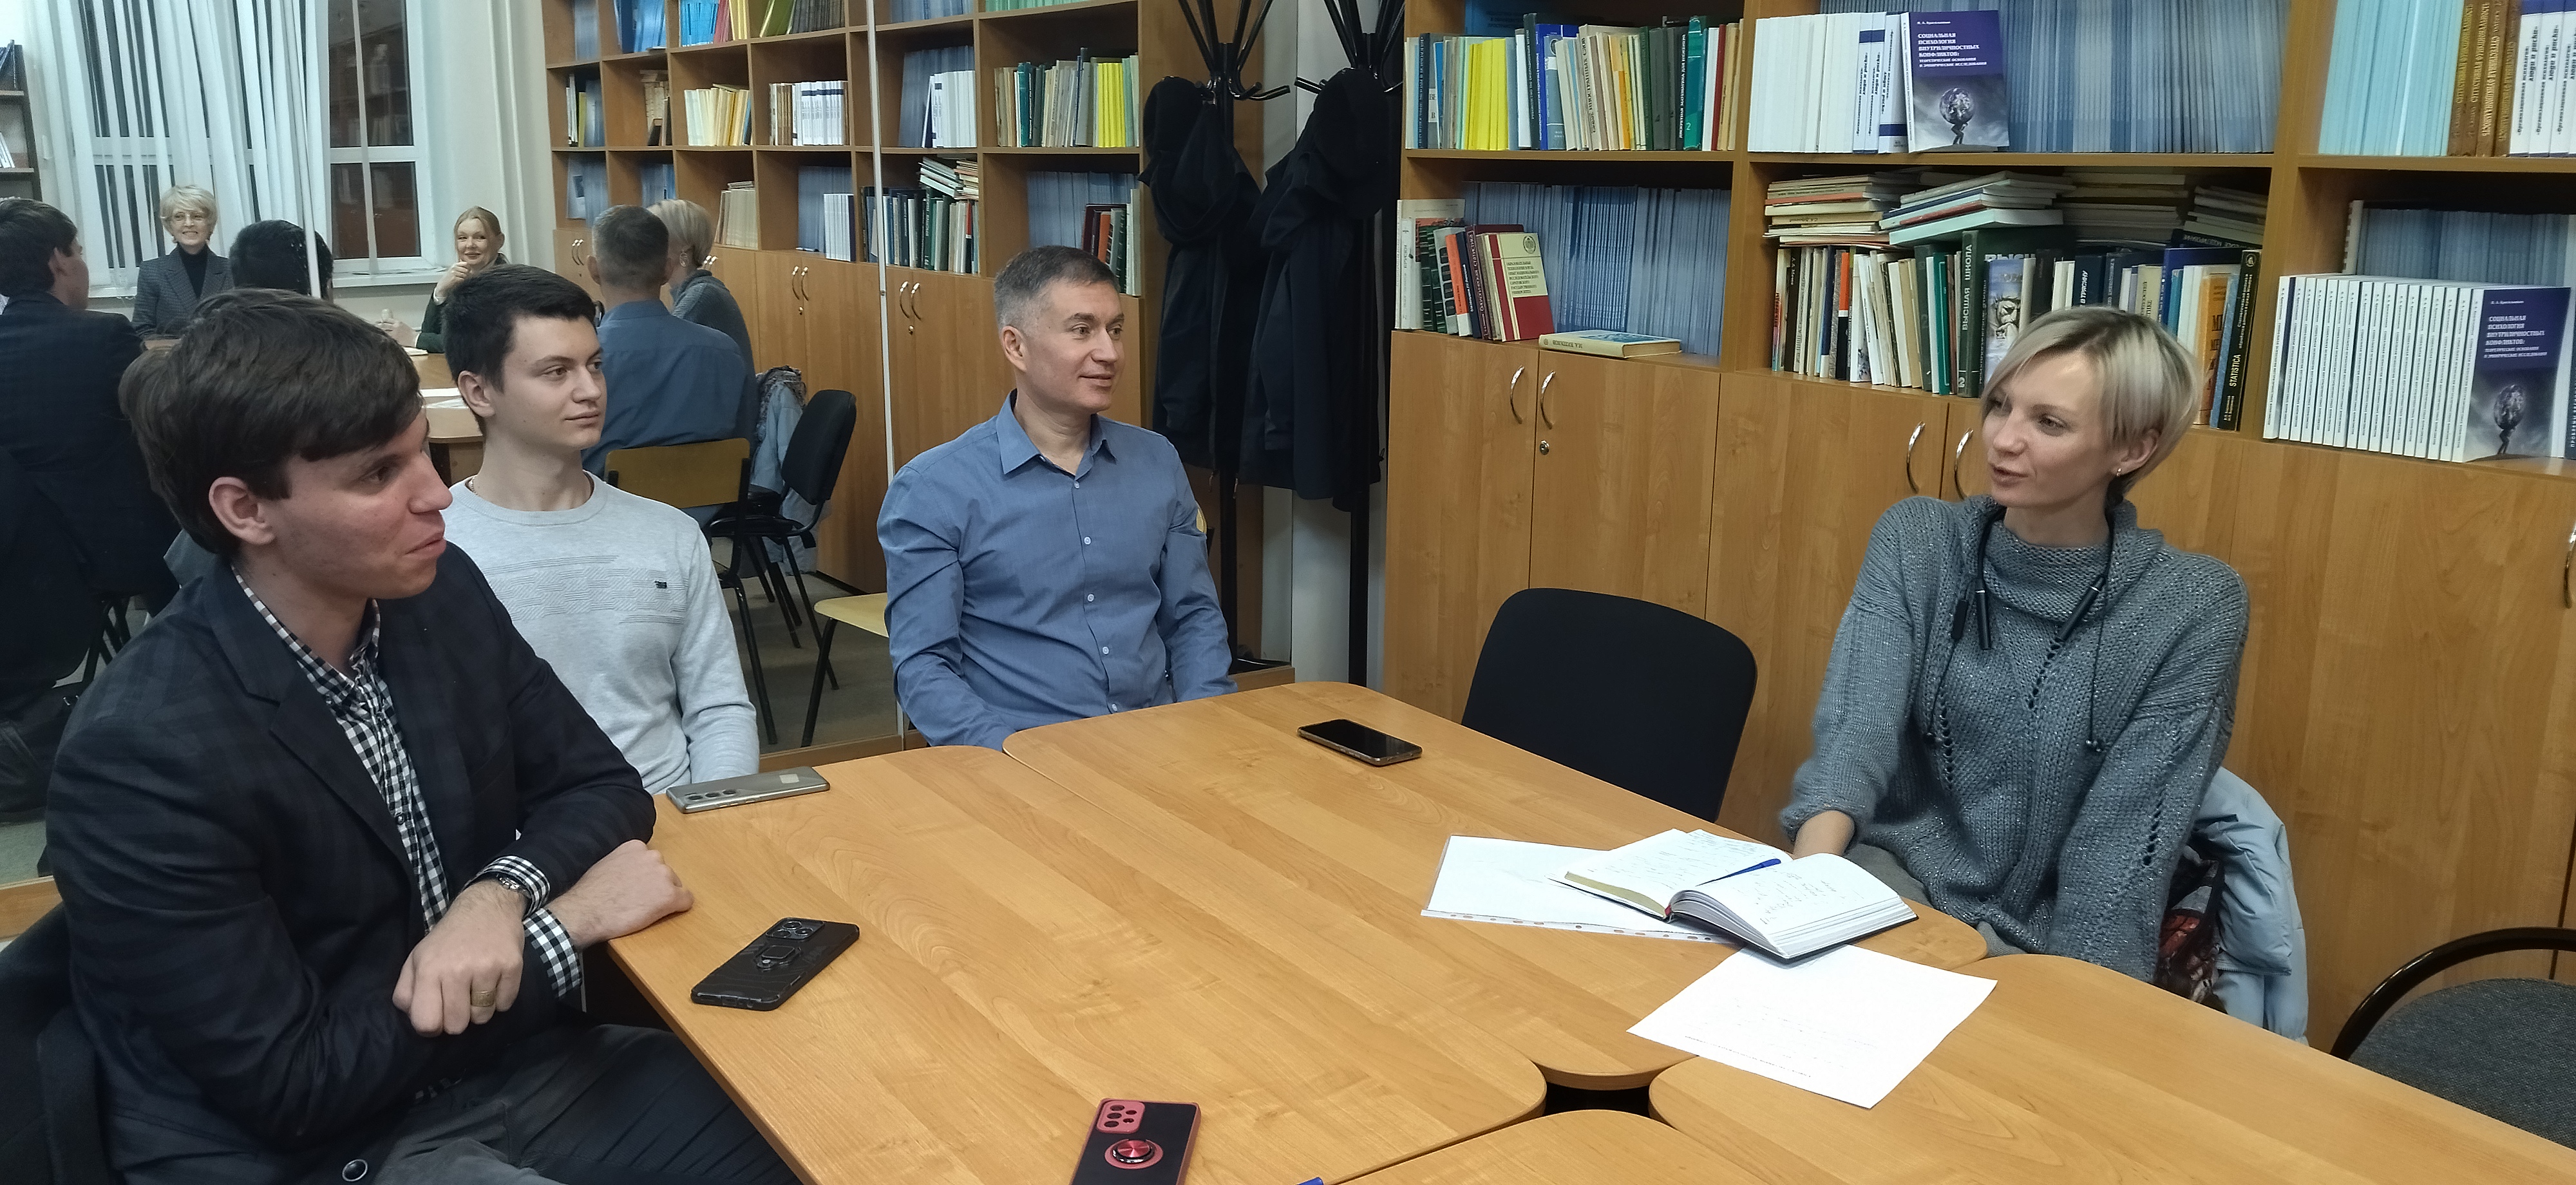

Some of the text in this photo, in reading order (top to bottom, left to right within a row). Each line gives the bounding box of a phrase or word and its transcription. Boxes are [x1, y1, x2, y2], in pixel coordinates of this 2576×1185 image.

[1584, 57, 1593, 110] ИНОСТРАННЫХ
[1962, 288, 1971, 330] ВЫСШАЯ
[2229, 353, 2241, 387] STATISTICA
